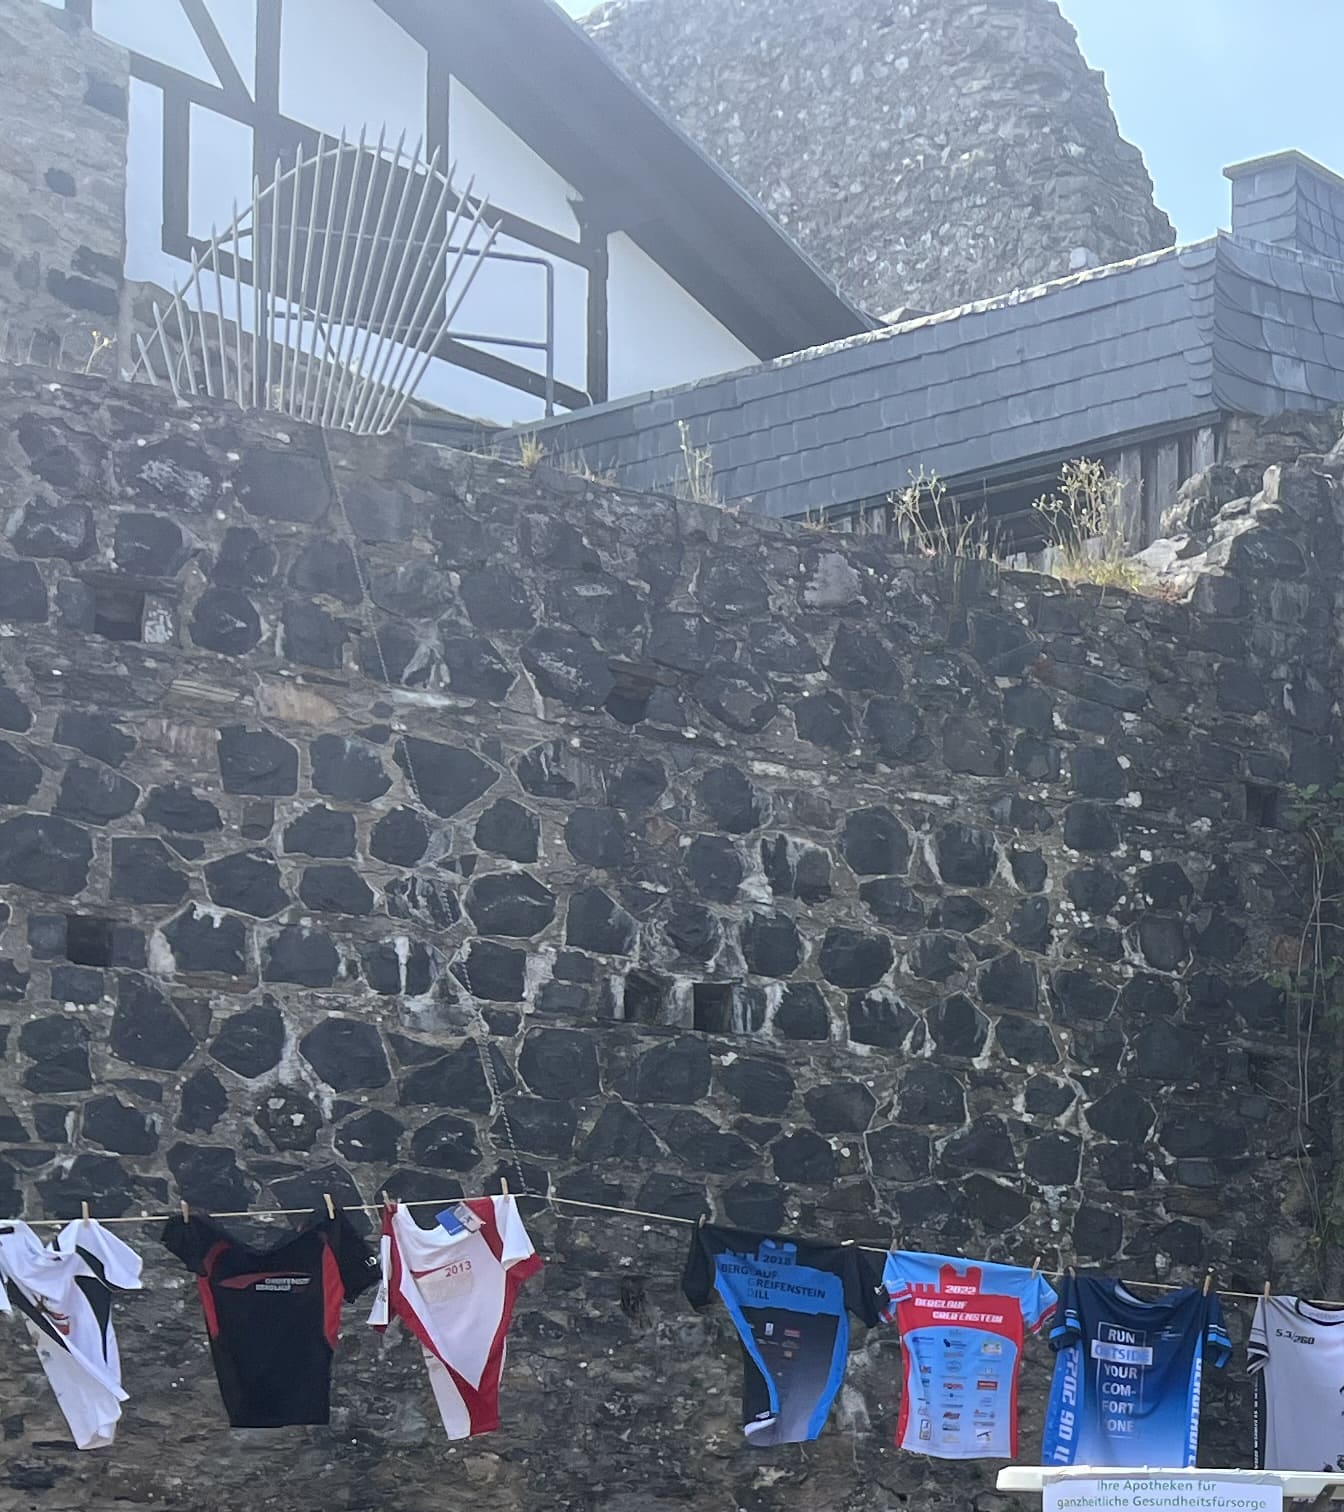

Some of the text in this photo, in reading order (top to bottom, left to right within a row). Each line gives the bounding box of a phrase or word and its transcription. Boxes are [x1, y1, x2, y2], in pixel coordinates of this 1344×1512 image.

[444, 1260, 472, 1277] 2013
[1108, 1328, 1136, 1345] RUN
[1103, 1363, 1138, 1380] YOUR
[1102, 1399, 1135, 1416] FORT
[1097, 1479, 1217, 1493] Ihre Apotheken für
[1057, 1495, 1267, 1511] ganzheitliche Gesundheitsfürsorge
